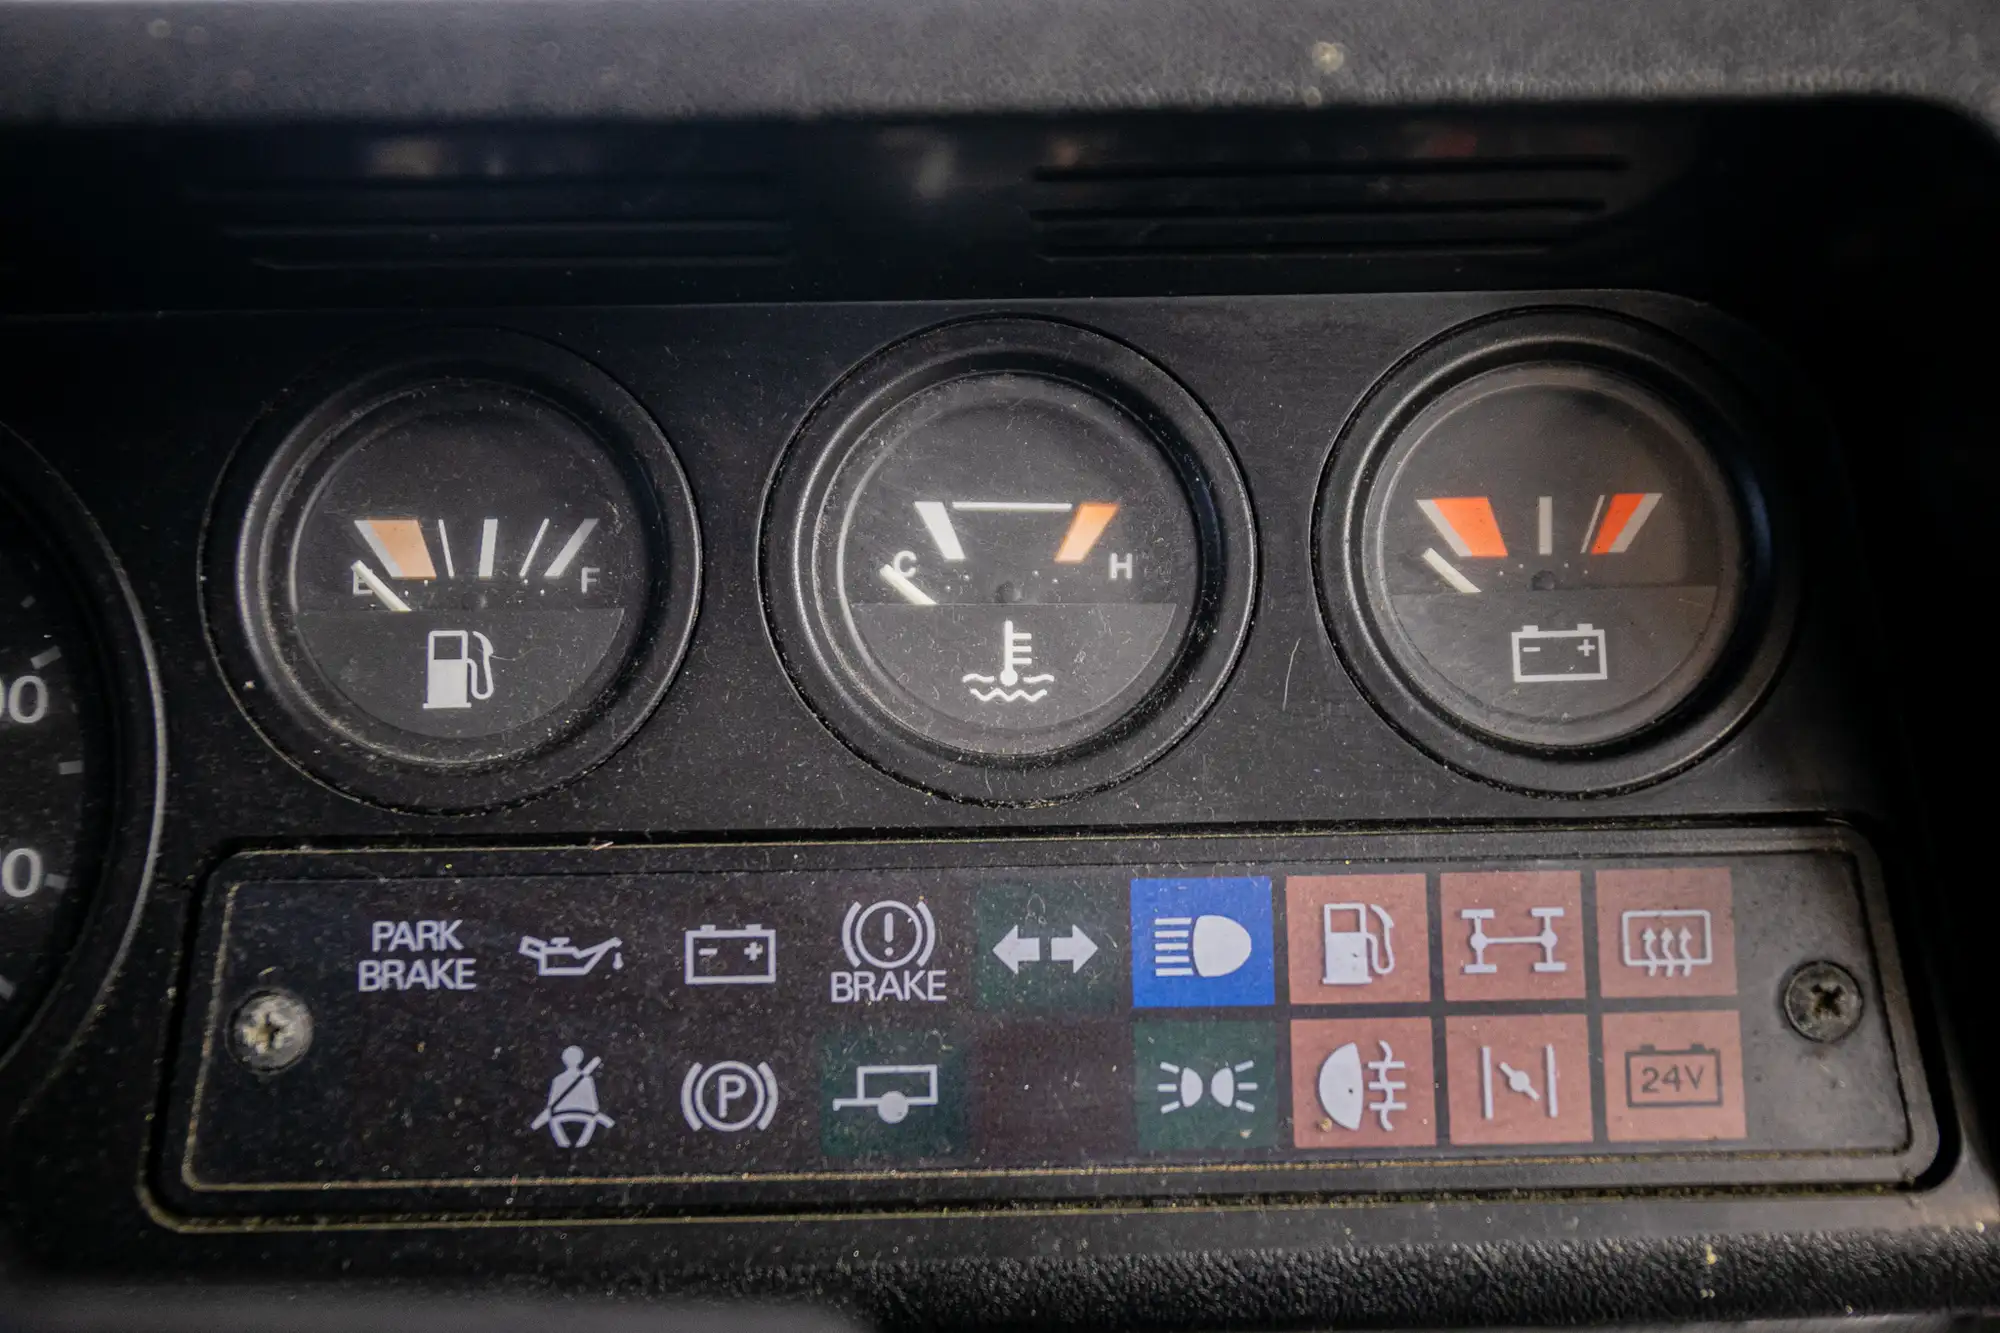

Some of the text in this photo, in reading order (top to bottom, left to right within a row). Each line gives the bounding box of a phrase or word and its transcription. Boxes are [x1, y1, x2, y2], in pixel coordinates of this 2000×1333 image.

[581, 567, 600, 593] F
[893, 551, 917, 578] C
[1109, 553, 1133, 579] H
[0, 675, 49, 723] 0
[372, 919, 464, 952] PARK
[358, 958, 477, 992] BRAKE
[830, 970, 947, 1002] BRAKE
[1641, 1064, 1705, 1094] 24V
[718, 1074, 747, 1118] P
